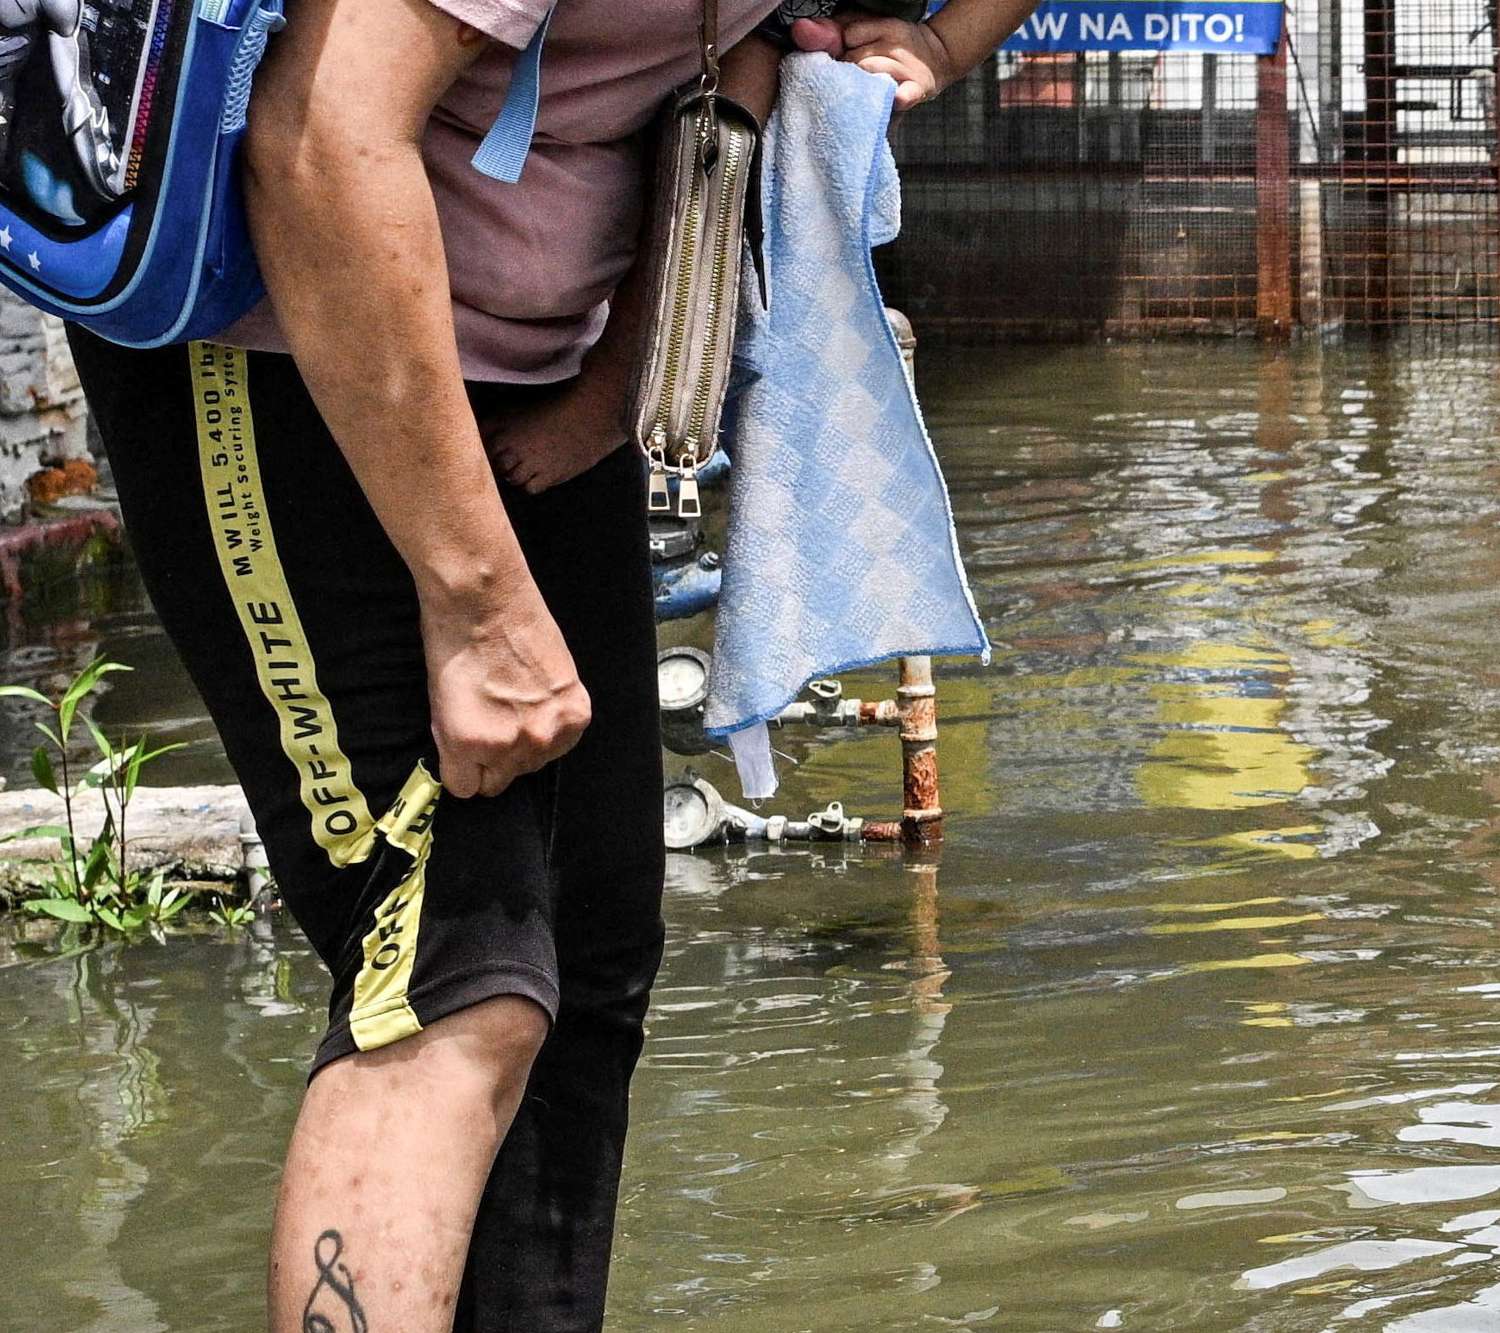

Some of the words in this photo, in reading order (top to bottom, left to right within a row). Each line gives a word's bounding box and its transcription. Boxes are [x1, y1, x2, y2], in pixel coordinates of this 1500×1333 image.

[1080, 13, 1133, 42] NA
[1144, 12, 1246, 44] DITO!
[222, 345, 238, 397] Syste
[203, 389, 230, 468] 5.400
[228, 406, 249, 485] Securing
[241, 491, 265, 553] Weight
[246, 601, 358, 836] OFF-WHITE
